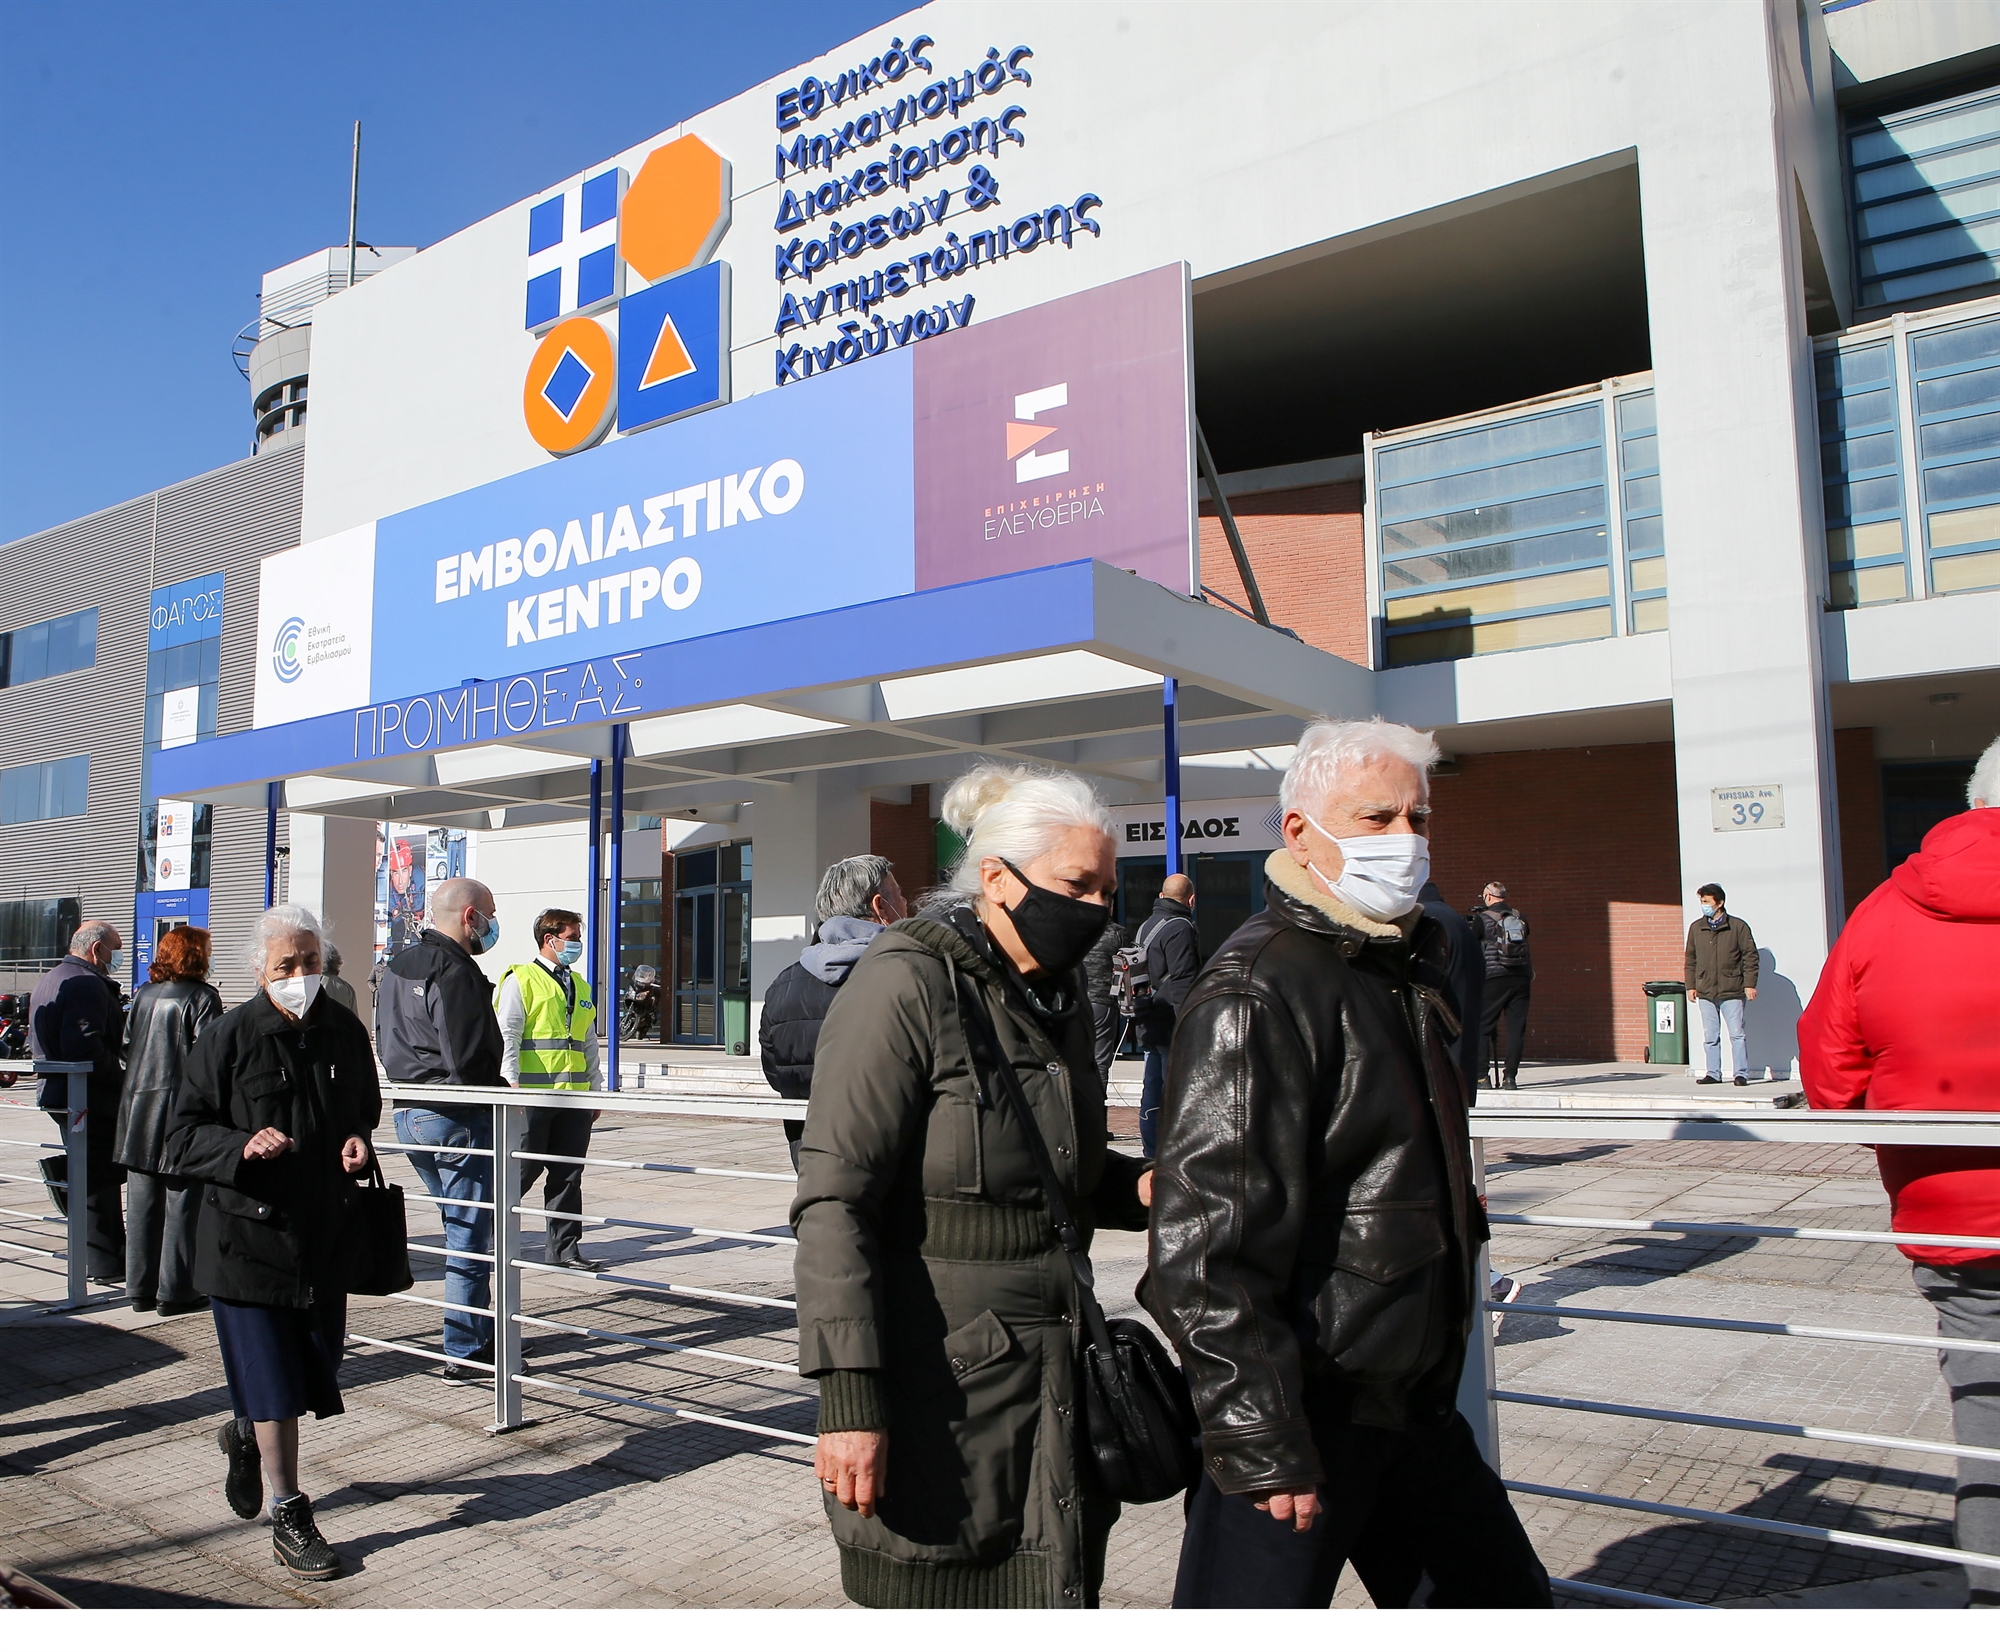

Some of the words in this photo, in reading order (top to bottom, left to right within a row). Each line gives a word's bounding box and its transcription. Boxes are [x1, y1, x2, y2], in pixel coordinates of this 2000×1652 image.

[775, 44, 1034, 183] Μηχανισμός
[776, 34, 935, 133] Εθνικός
[774, 104, 1027, 233] Διαχείρισης
[775, 189, 950, 285] Κρίσεων
[964, 164, 1001, 210] &
[774, 192, 1103, 337] Αντιμετώπισης
[775, 293, 976, 387] Κινδύνων
[435, 458, 805, 604] ΕΜΒΟΛΙΑΣΤΙΚΟ
[984, 482, 1105, 517] ΕΠΙΧΕΙΡΗΣΗ
[984, 497, 1105, 540] ΕΛΕΥΘΕΡΙΑ
[152, 589, 221, 631] ΦΑΡΟΣ
[308, 622, 331, 638] Εθνική
[506, 556, 703, 648] ΚΕΝΤΡΟ
[307, 633, 346, 651] Εκστρατεία
[307, 644, 352, 666] Εμβολιασμού
[353, 652, 643, 760] ΠΡΟΜΗΘΕΑΣ
[1718, 790, 1755, 801] KIFISSIAS
[1732, 801, 1765, 825] 39
[1126, 817, 1240, 842] ΕΙΣΔΟΣ
